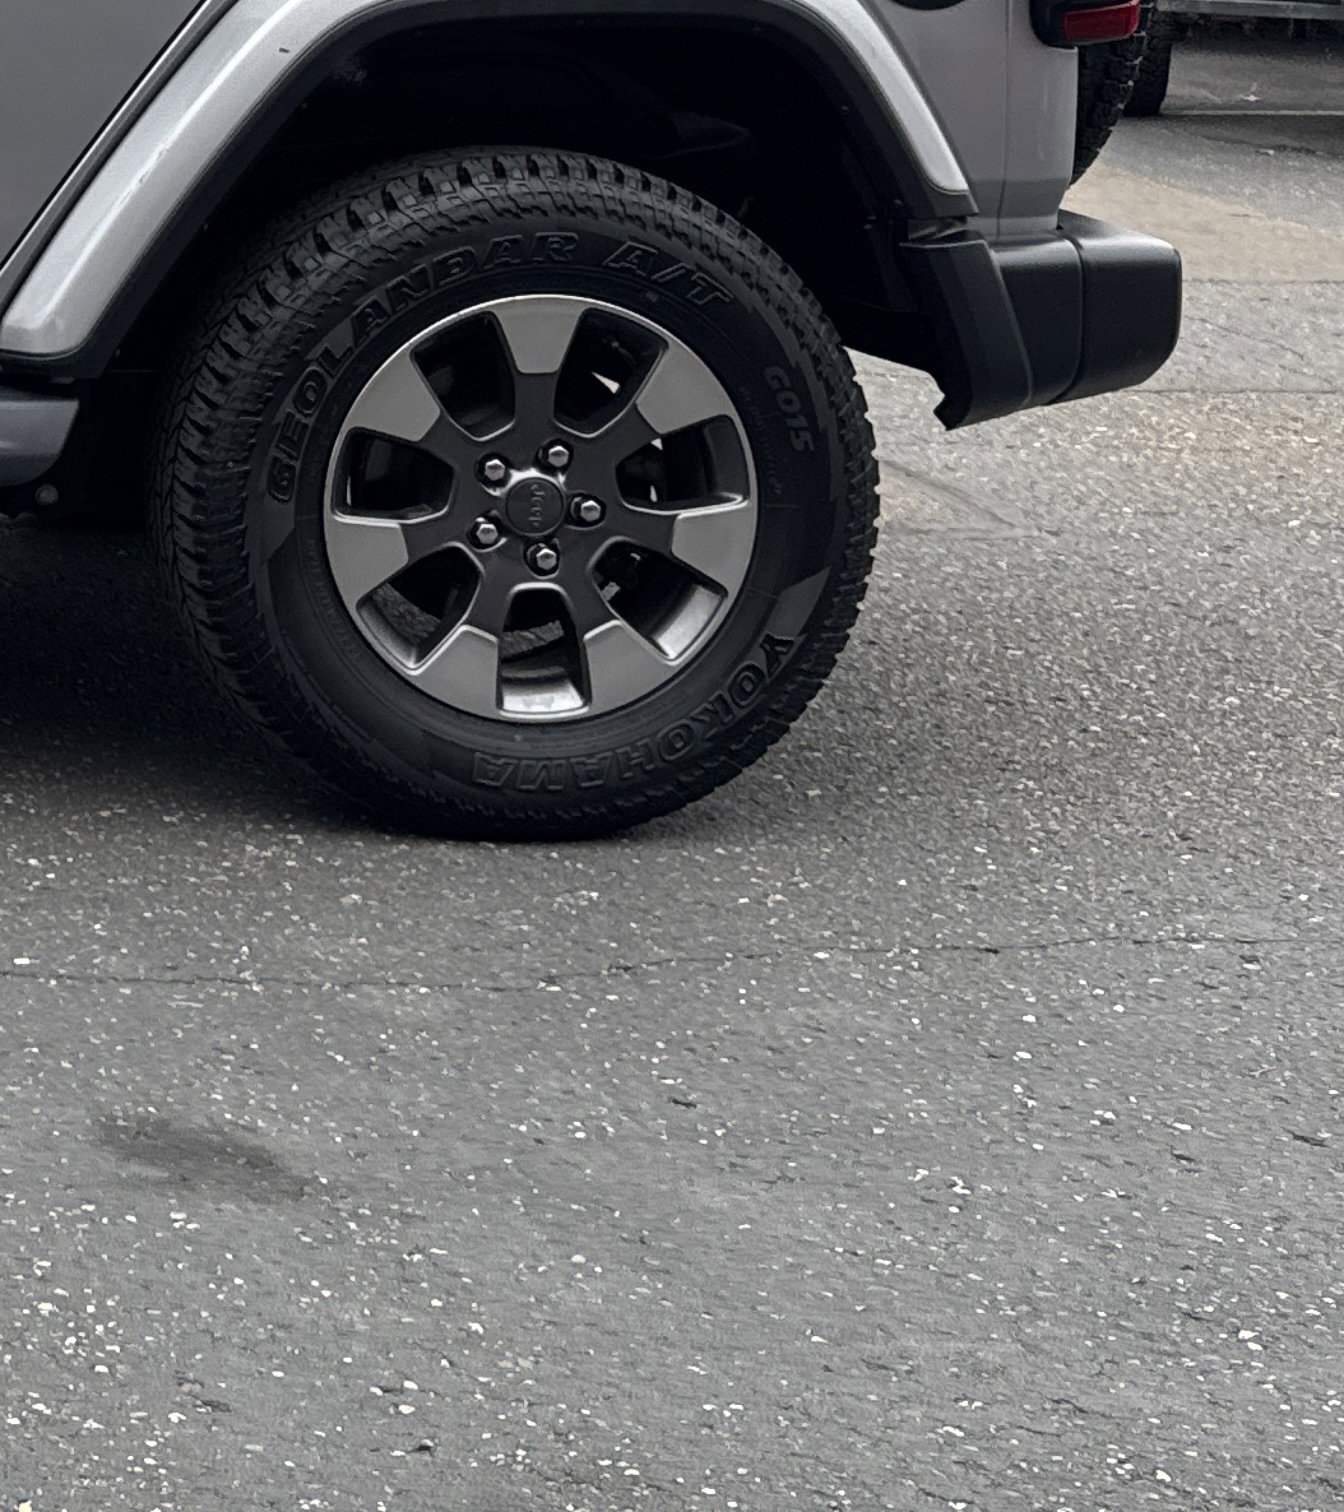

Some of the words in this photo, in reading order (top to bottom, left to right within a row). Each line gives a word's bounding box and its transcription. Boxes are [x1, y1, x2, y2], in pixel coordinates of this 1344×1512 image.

[265, 230, 580, 506] GEOLANDAR
[600, 240, 738, 310] A/T
[470, 631, 796, 792] YOKOHAMA
